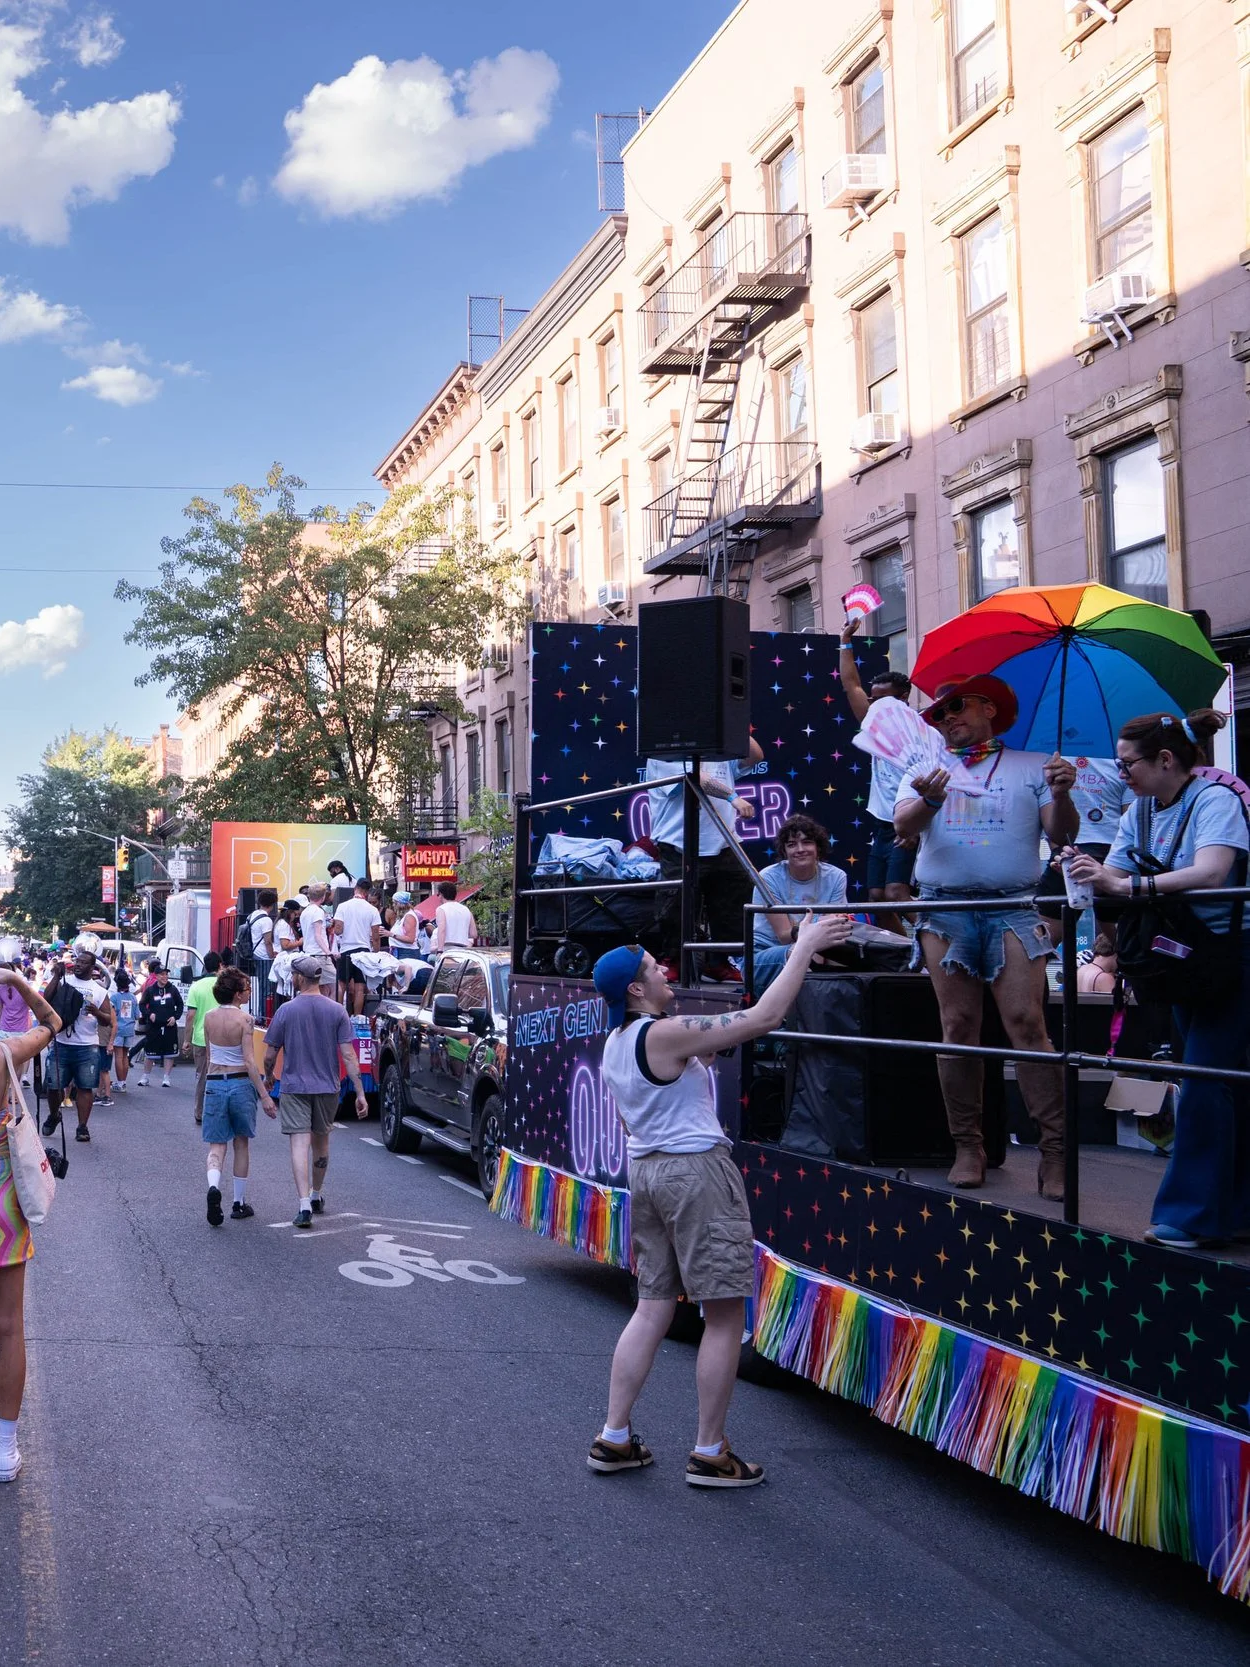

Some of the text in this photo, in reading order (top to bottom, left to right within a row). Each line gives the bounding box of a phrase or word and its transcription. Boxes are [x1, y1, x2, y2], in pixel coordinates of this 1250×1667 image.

[1077, 773, 1108, 785] MBA
[406, 850, 458, 865] BOGOTA
[408, 868, 429, 876] LATIN
[515, 1007, 560, 1047] NEXT
[563, 997, 603, 1040] GEN
